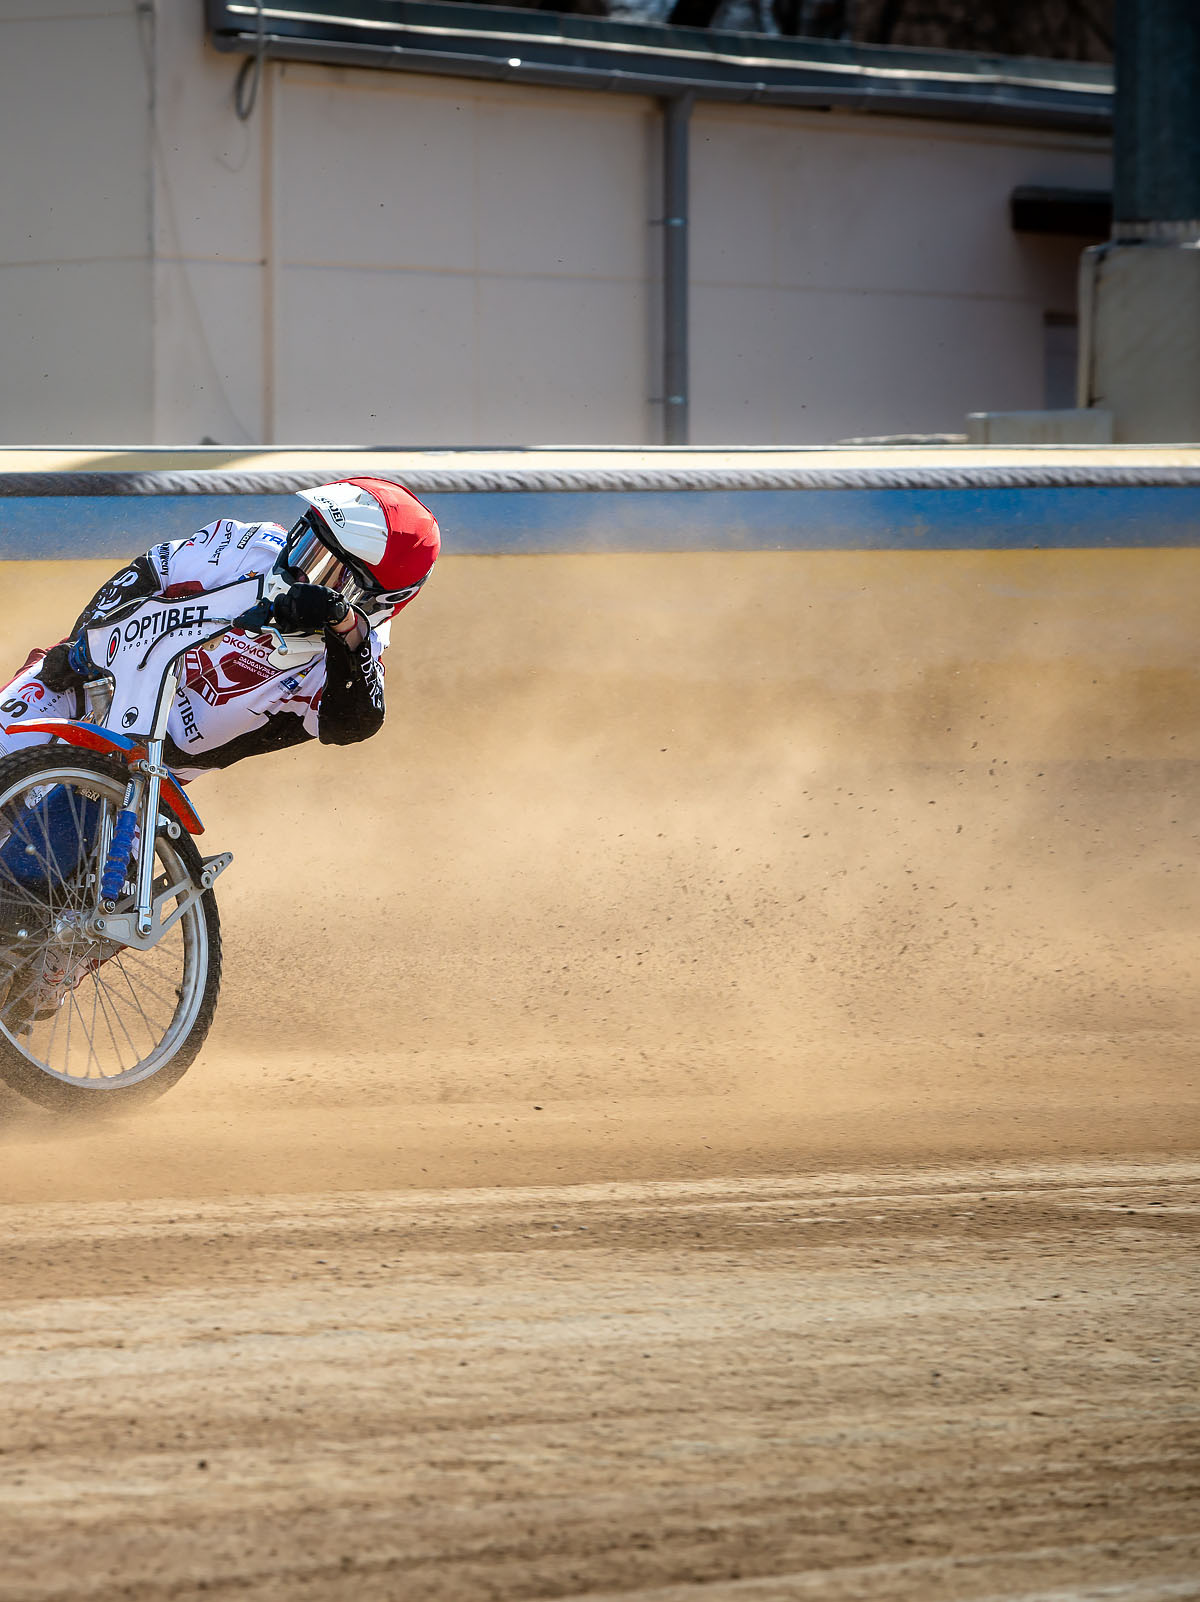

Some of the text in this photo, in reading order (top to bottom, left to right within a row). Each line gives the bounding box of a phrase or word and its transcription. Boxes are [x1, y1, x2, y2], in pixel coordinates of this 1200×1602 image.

[208, 521, 234, 566] OPTIBET
[124, 605, 209, 643] OPTIBET
[122, 636, 160, 652] SPORT
[222, 634, 271, 659] OKOMO
[176, 687, 204, 743] PTIBET
